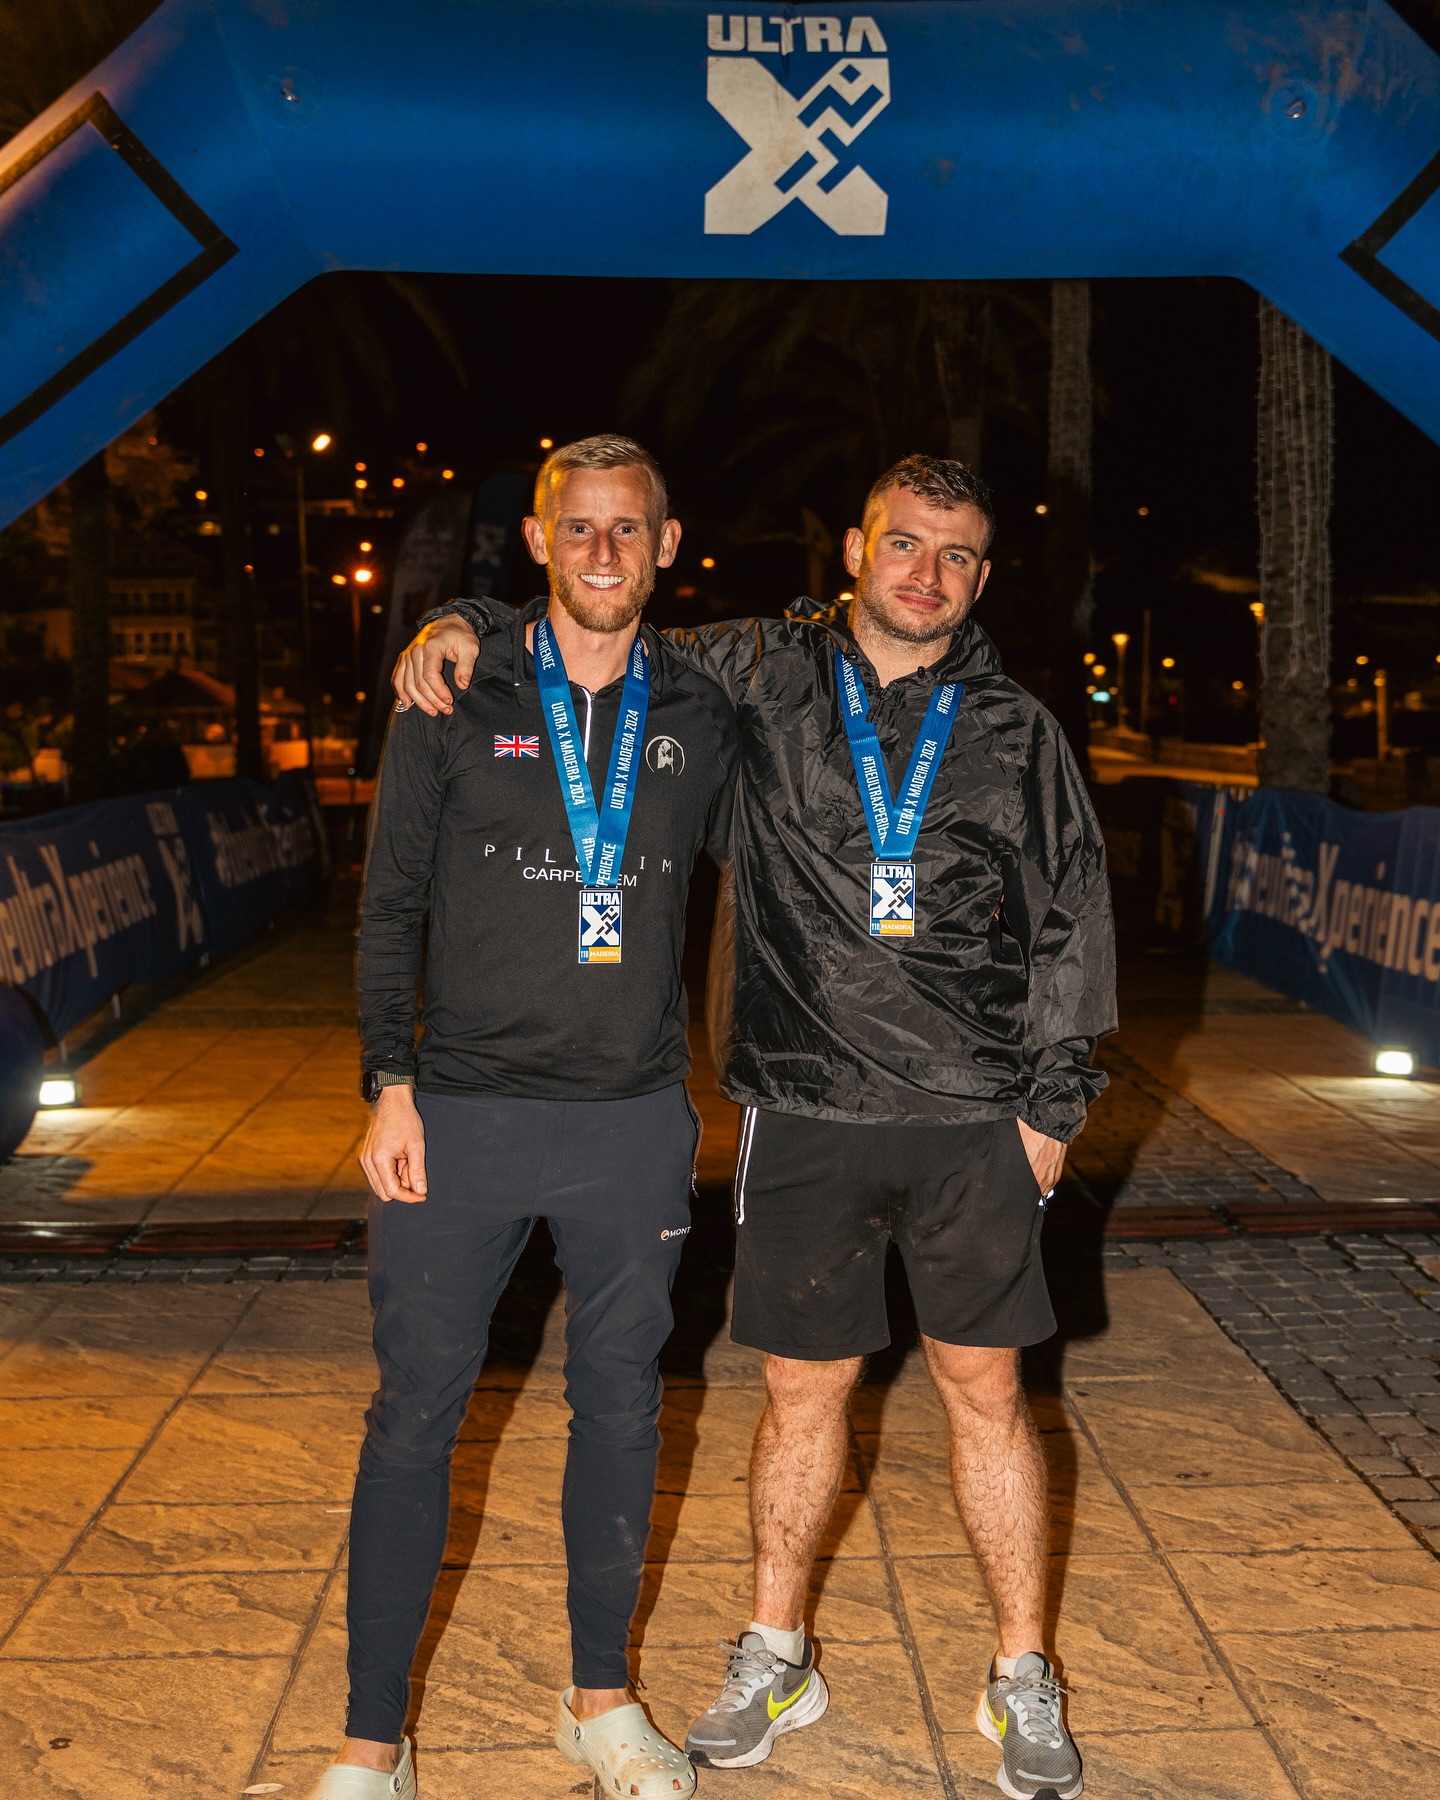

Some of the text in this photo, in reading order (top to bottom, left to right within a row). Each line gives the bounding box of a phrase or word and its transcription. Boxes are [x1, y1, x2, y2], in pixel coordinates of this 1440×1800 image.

[707, 14, 888, 56] ULTRA
[551, 701, 587, 806] ULTRA X MADEIRA 2024
[610, 709, 640, 810] ULTRA X MADEIRA 2024
[896, 739, 938, 835] ULTRA X MADEIRA 2024
[873, 865, 914, 879] ULTRA
[582, 892, 620, 906] ULTRA
[881, 923, 912, 931] MADEIRA
[670, 1226, 692, 1237] MONT
